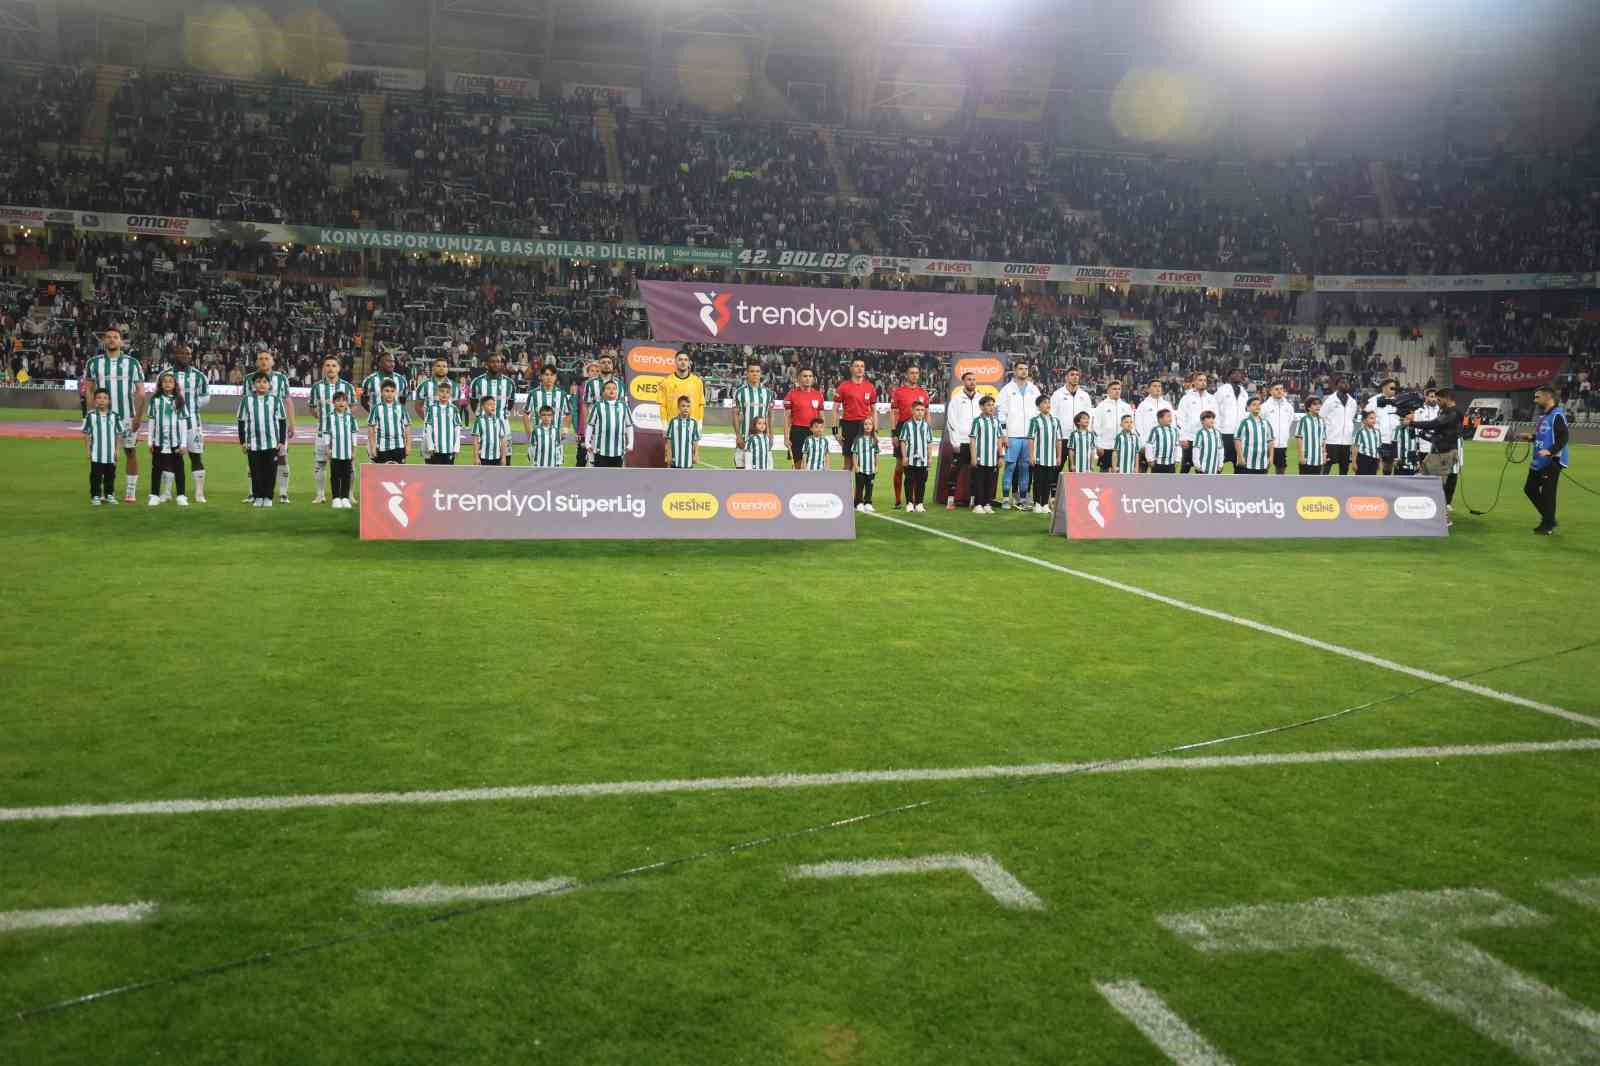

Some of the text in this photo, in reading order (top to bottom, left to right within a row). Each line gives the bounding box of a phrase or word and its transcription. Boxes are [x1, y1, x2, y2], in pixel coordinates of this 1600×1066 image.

[320, 229, 496, 252] KONYASPOR'UMUZA
[501, 240, 595, 257] BAŞARILAR
[600, 243, 666, 260] DİLERİM
[737, 249, 772, 265] 42.
[736, 300, 949, 337] trendyol SüperLig
[432, 489, 647, 518] trendyol SüperLig
[1120, 494, 1286, 519] trendyol SüperLig
